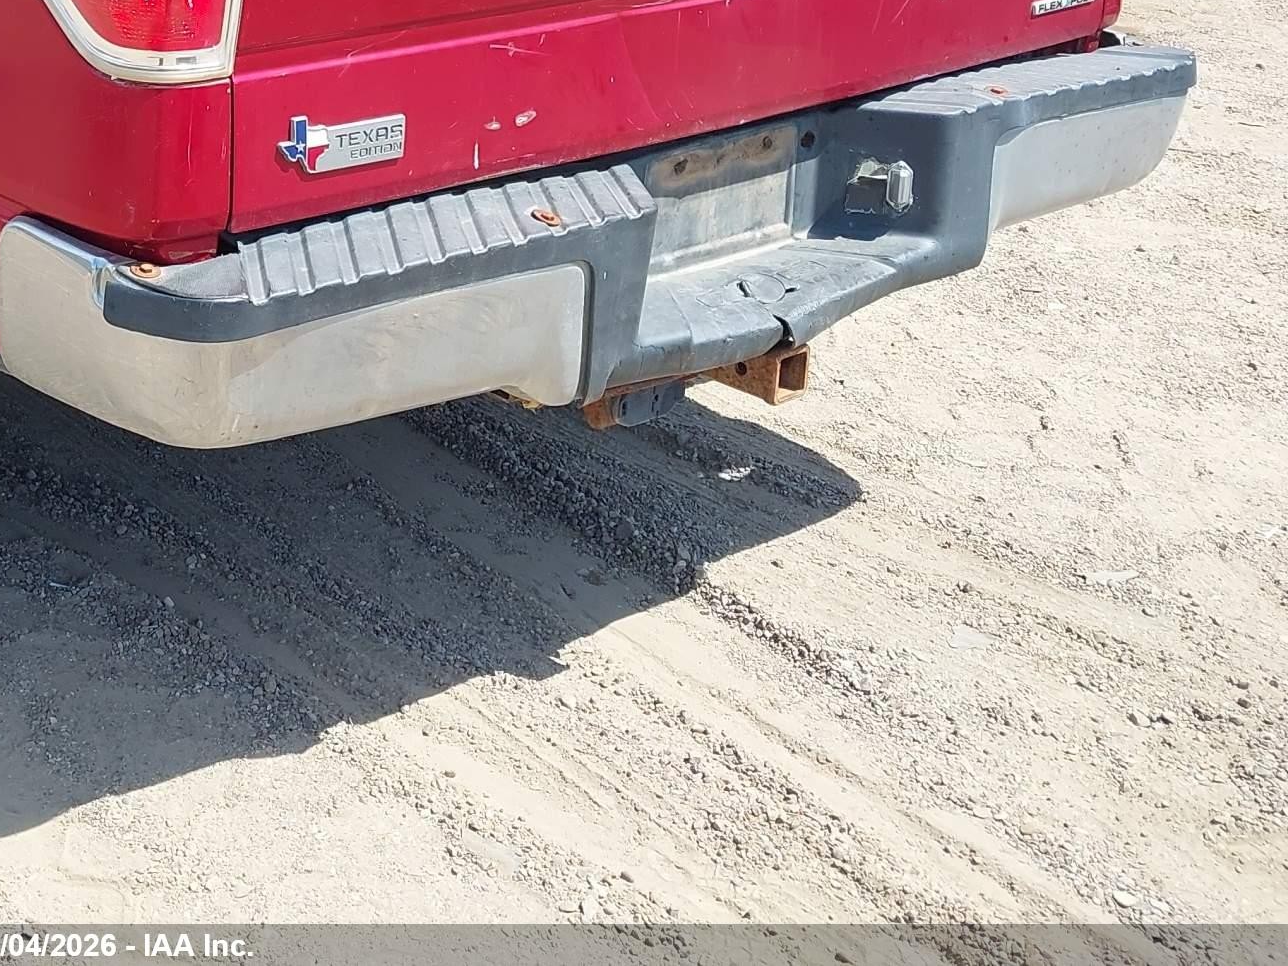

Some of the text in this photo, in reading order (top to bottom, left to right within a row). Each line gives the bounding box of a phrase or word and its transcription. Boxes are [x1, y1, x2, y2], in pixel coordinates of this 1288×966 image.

[1038, 0, 1063, 13] FLEX
[335, 124, 403, 148] TEXAS
[350, 142, 402, 159] EDITION
